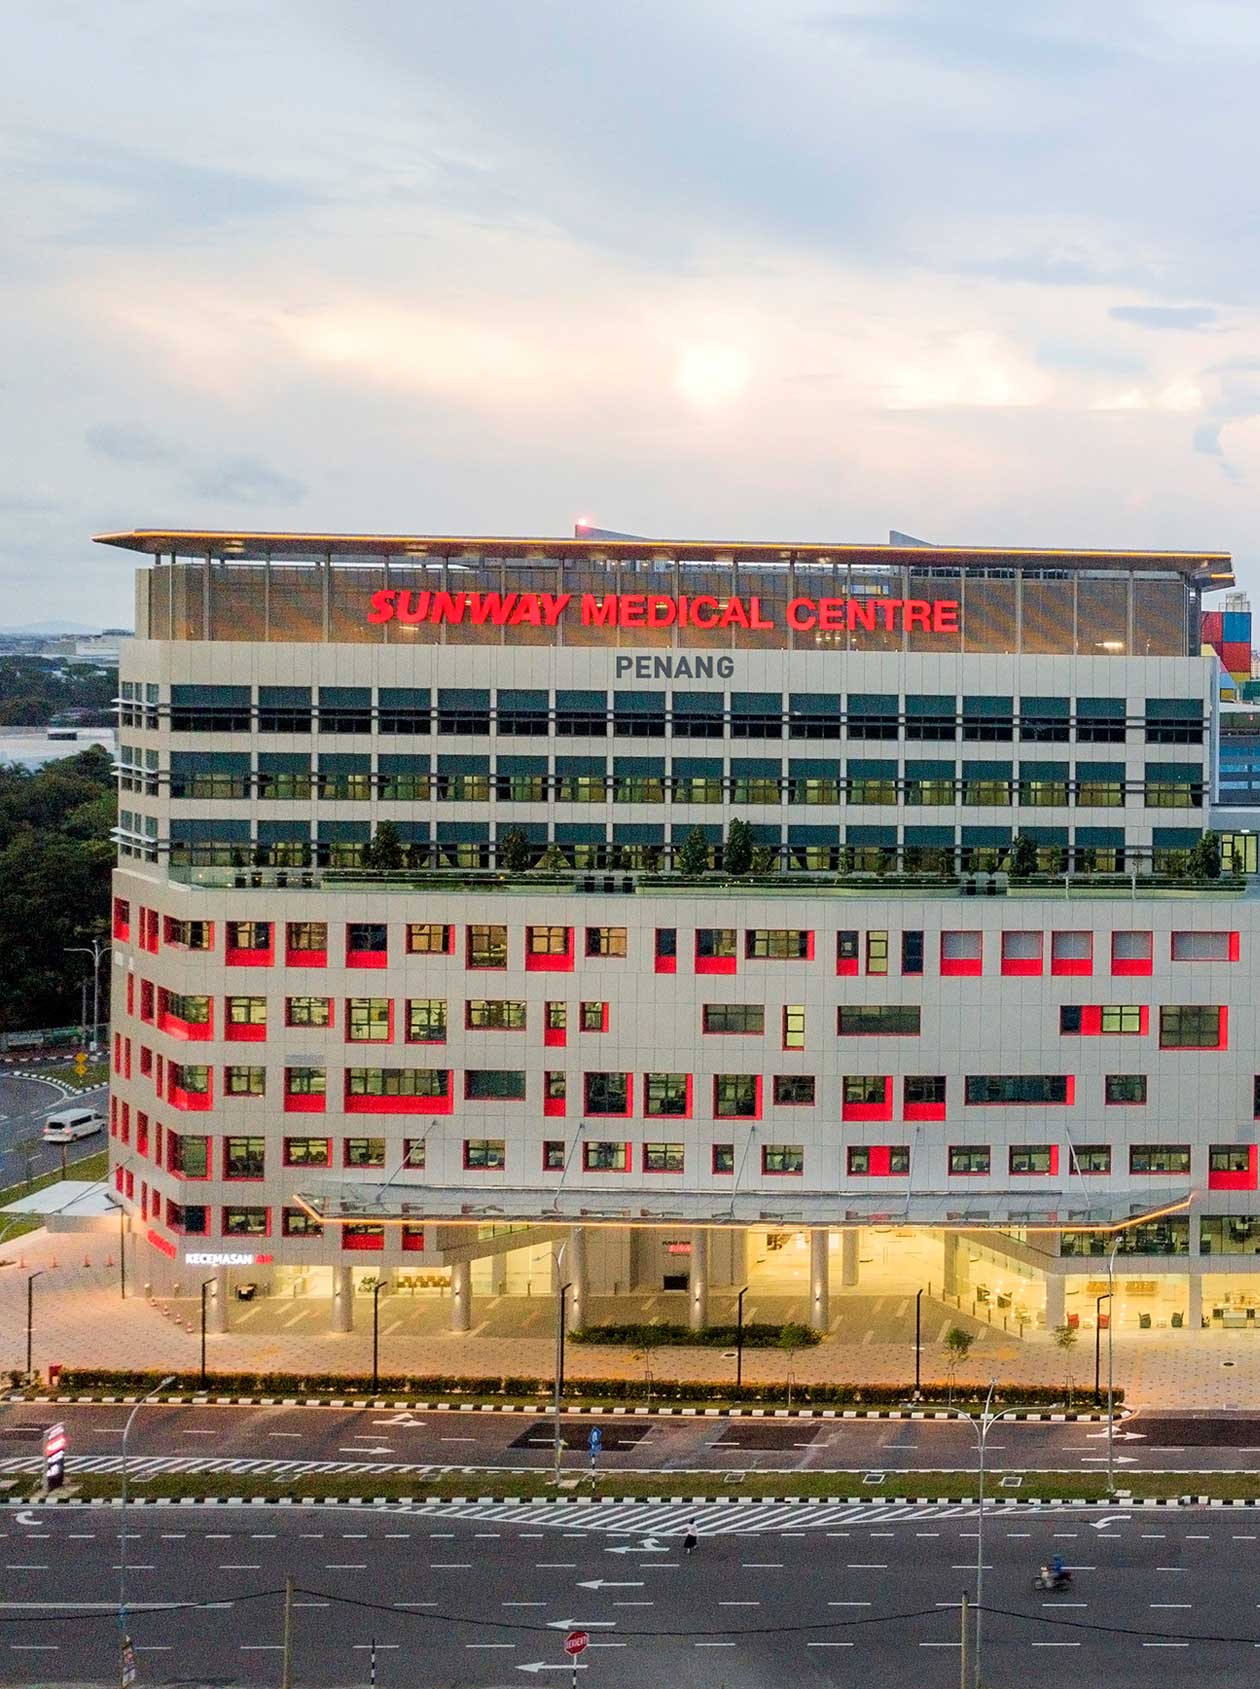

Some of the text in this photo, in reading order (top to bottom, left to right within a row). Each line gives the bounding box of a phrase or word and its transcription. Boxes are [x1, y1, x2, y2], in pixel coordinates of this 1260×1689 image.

[367, 589, 959, 633] SUNWAY MEDICAL CENTRE
[616, 655, 735, 679] PENANG
[185, 1253, 252, 1265] KECEMASAN
